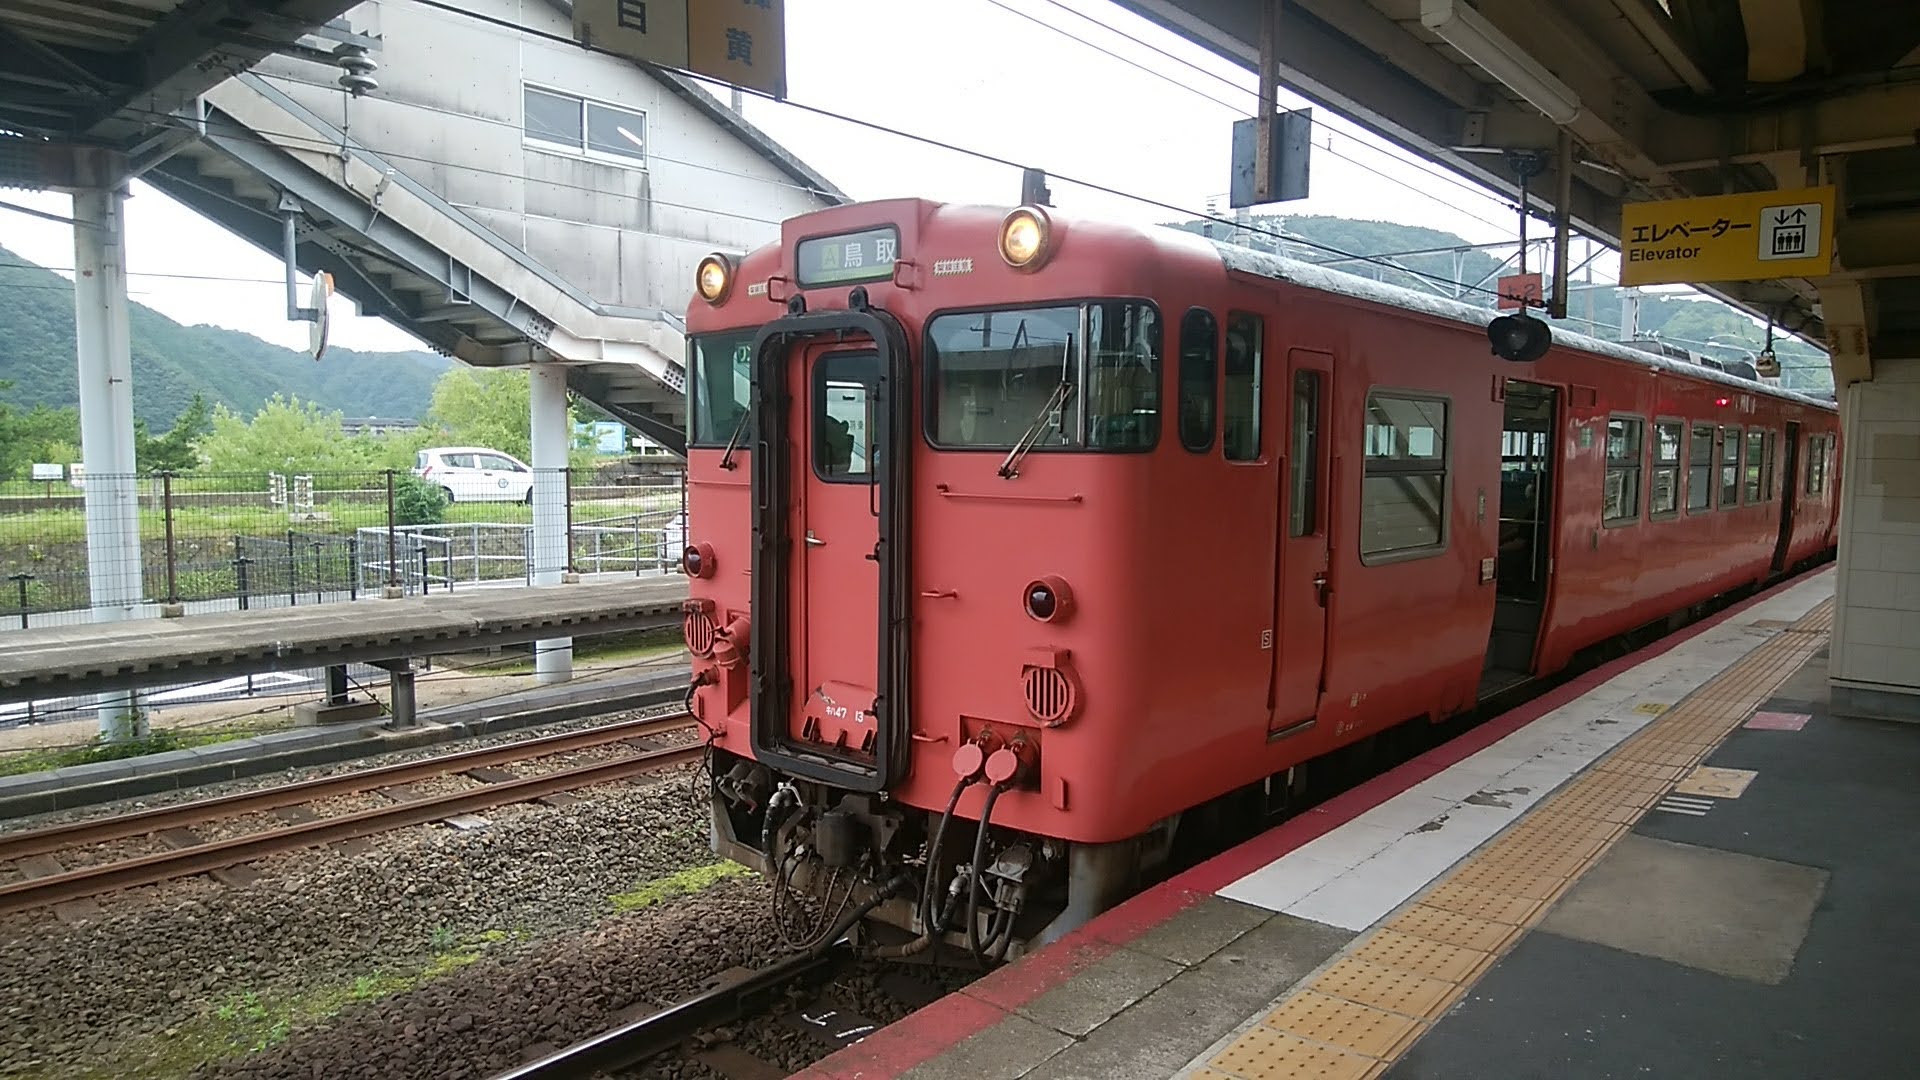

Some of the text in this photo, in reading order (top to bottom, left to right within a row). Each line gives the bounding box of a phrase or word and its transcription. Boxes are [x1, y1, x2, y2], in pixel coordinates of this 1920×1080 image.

[1631, 218, 1752, 243] エレベーター
[844, 238, 896, 269] 鳥取
[1629, 246, 1701, 262] Elevator
